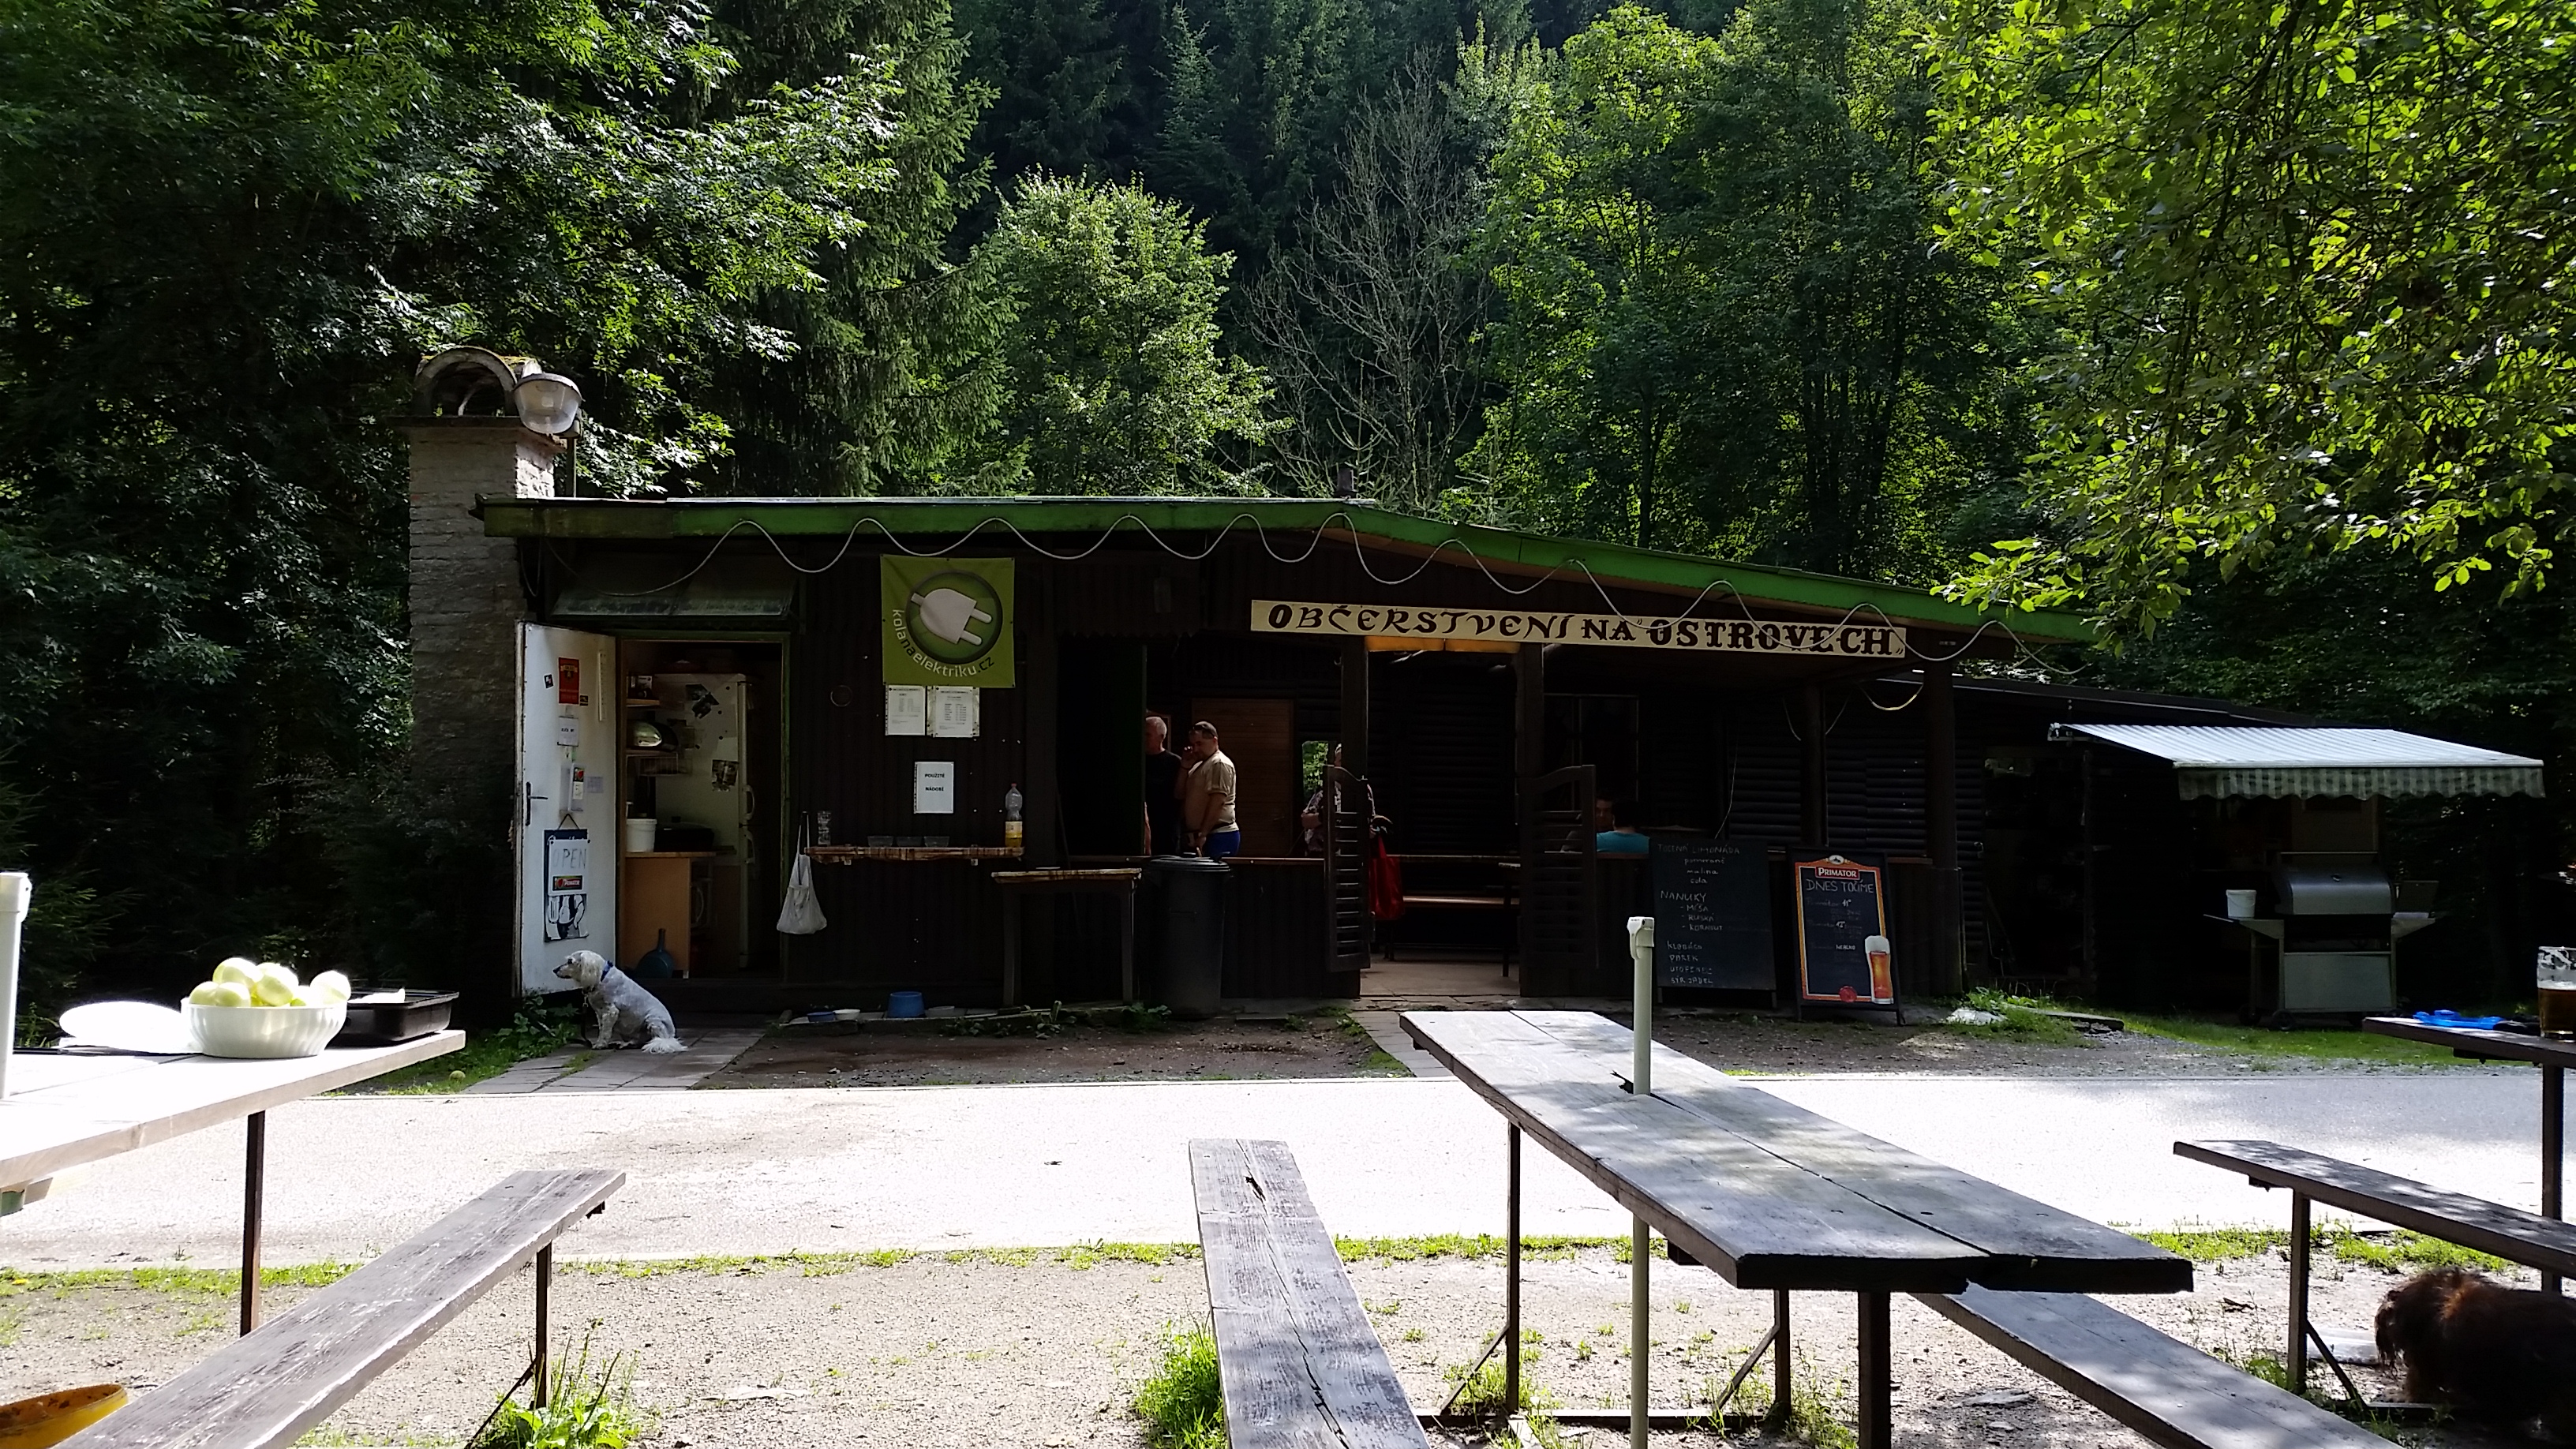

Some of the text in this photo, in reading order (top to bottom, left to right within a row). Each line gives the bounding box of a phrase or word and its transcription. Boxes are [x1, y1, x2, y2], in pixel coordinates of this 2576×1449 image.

[1267, 603, 1576, 640] OBČERSTVENÍ
[1581, 618, 1637, 642] NA
[892, 608, 995, 677] kolanaelektriku.cz
[1692, 843, 1740, 855] LIMONÁDA
[552, 848, 587, 870] OPEN
[1818, 867, 1857, 878] PRIMATOR
[1806, 878, 1874, 893] DNES TOČÍME
[1661, 890, 1707, 903] NANUKY
